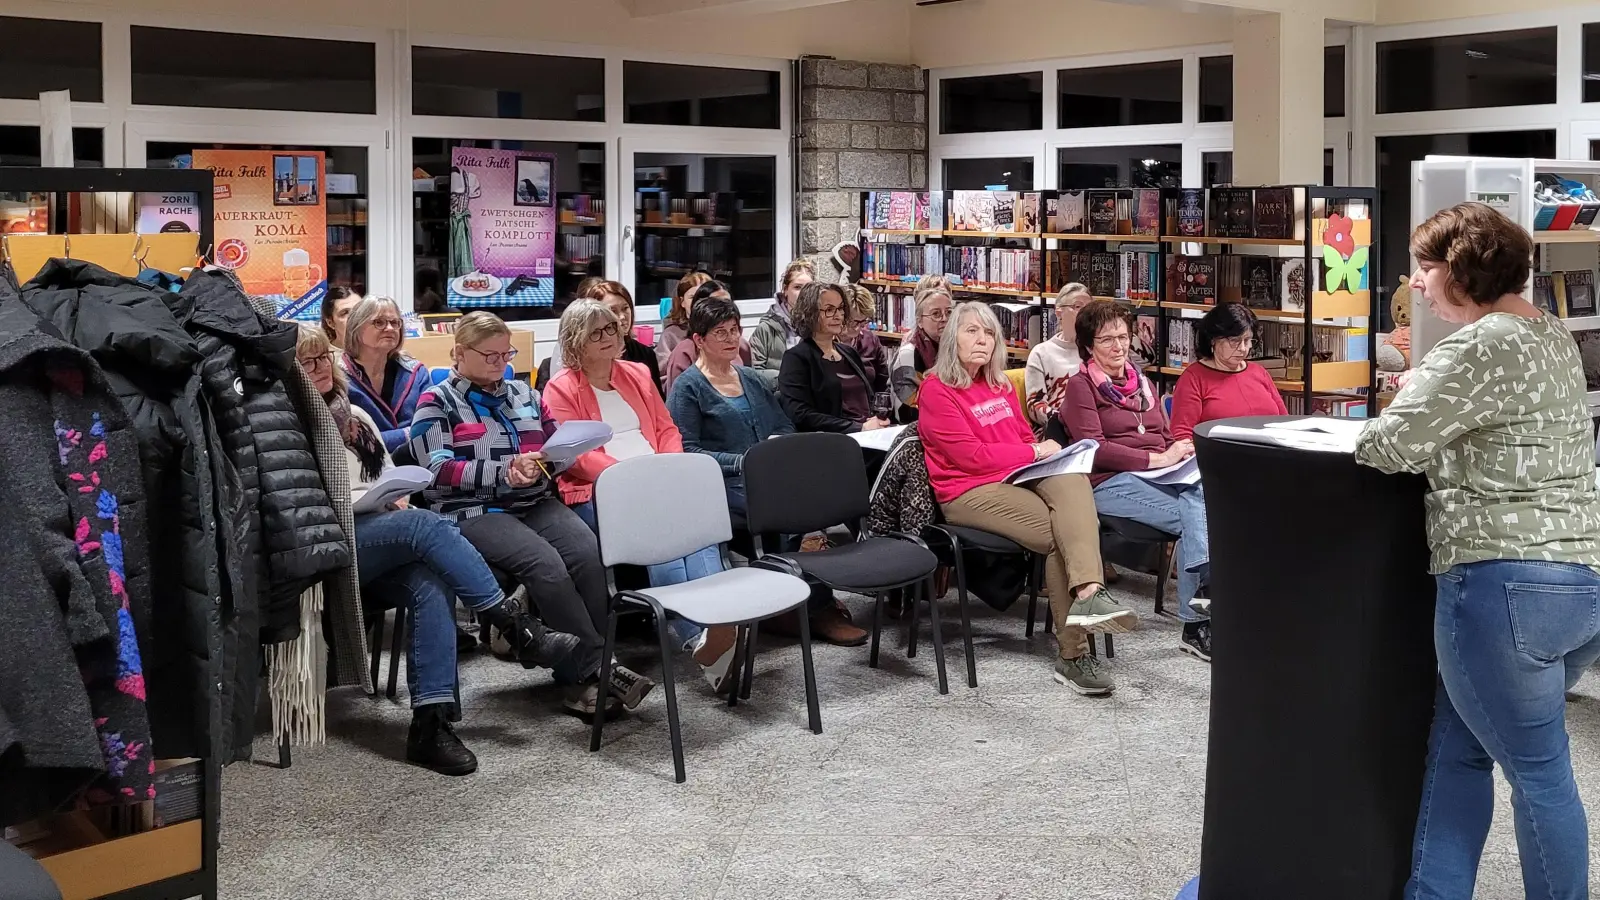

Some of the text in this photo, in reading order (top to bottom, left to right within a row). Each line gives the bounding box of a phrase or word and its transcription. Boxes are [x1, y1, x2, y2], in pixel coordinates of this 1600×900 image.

[456, 154, 511, 169] Rita Falk
[238, 165, 267, 178] Falk
[161, 195, 190, 204] ZORN
[159, 207, 193, 215] RACHE
[214, 211, 298, 221] AUERKRAUT-
[480, 208, 549, 219] ZWETSCHGEN-
[495, 219, 538, 228] DATSCHI-
[253, 224, 308, 237] KOMA
[484, 230, 552, 240] KOMPLOTT
[1091, 255, 1114, 264] PRISON
[1565, 273, 1594, 286] SAFARI
[1187, 286, 1214, 297] AFTER
[288, 307, 297, 315] im
[294, 287, 324, 310] Taschenbuch
